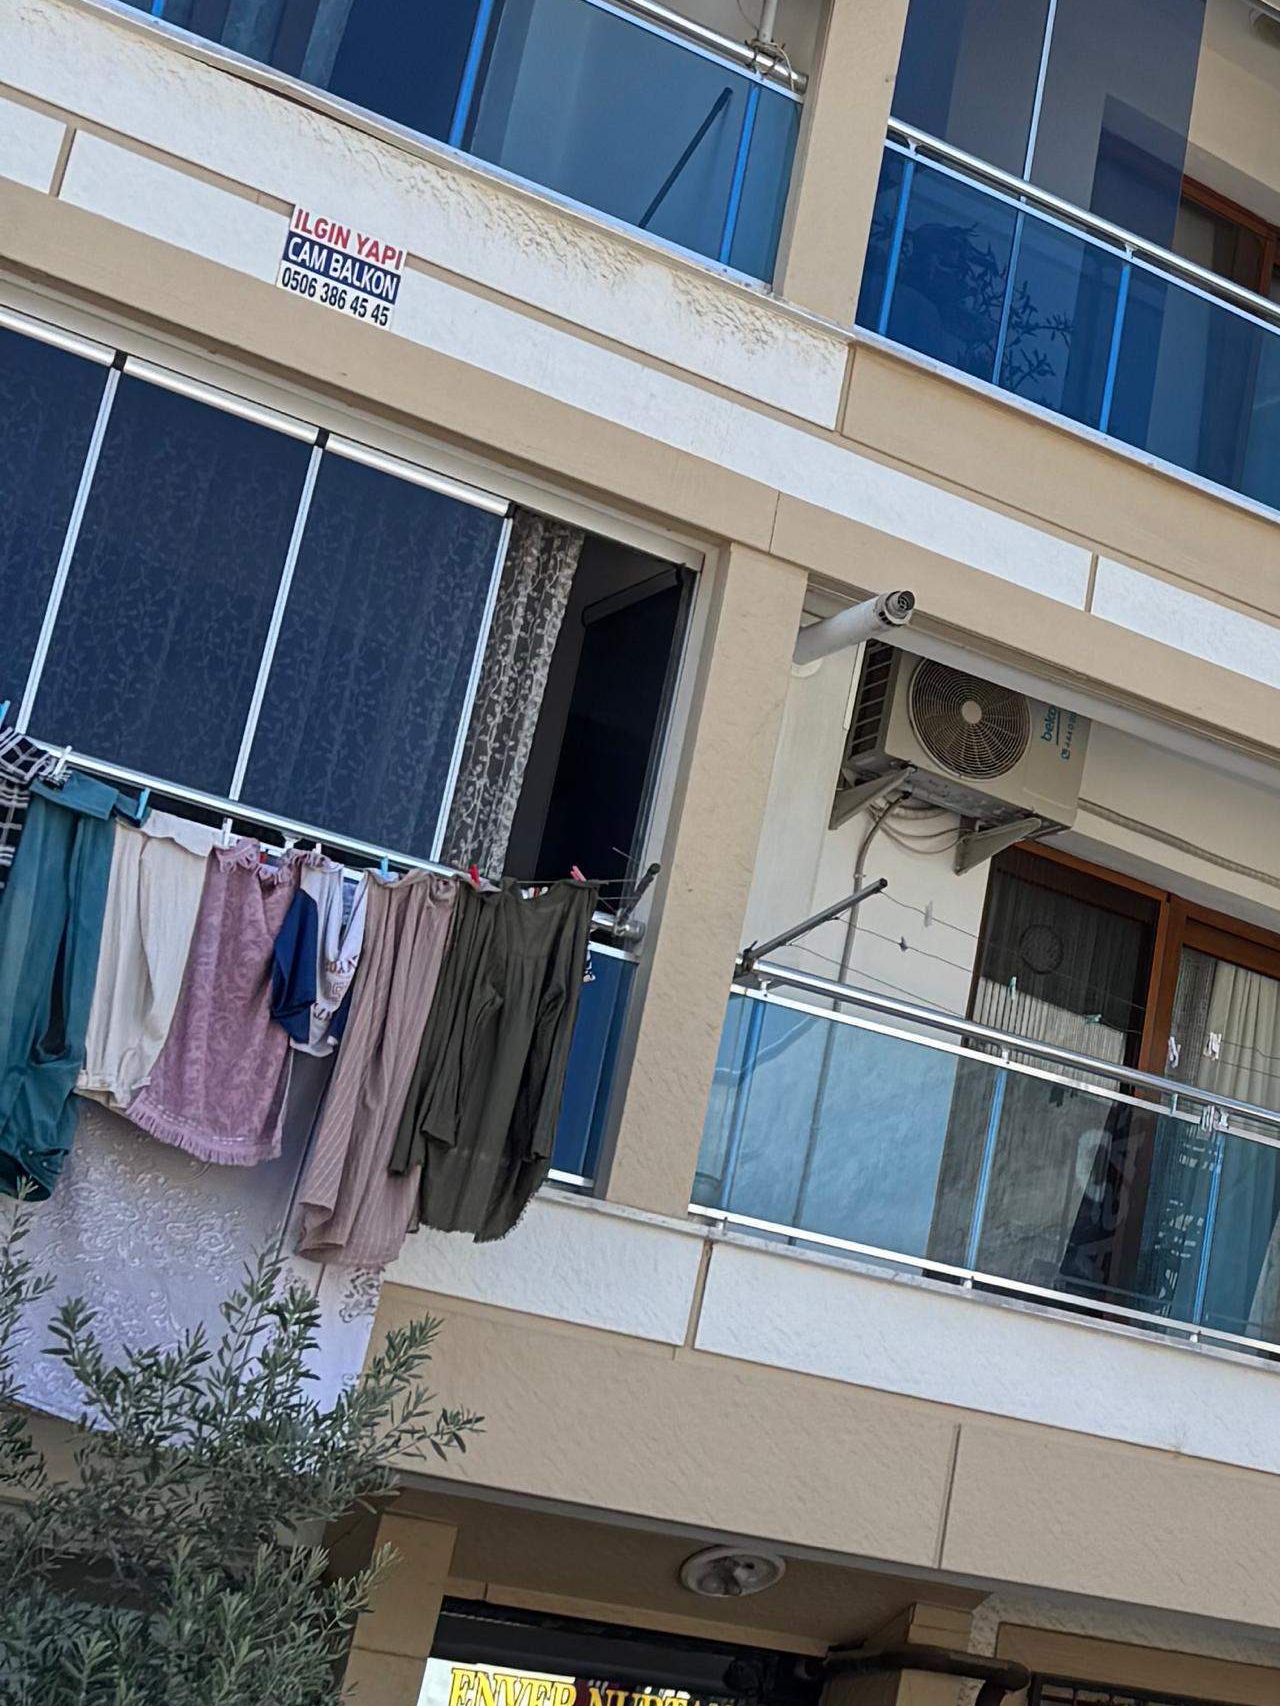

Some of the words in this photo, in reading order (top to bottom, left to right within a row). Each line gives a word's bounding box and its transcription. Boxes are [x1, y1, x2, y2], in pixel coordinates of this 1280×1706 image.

[288, 236, 328, 272] CAM
[329, 252, 397, 301] BALKON
[294, 208, 351, 249] ILGIN
[356, 232, 403, 270] YAPI
[281, 266, 318, 298] 0506
[319, 281, 347, 310] 386
[350, 295, 369, 318] 45
[371, 305, 390, 326] 45
